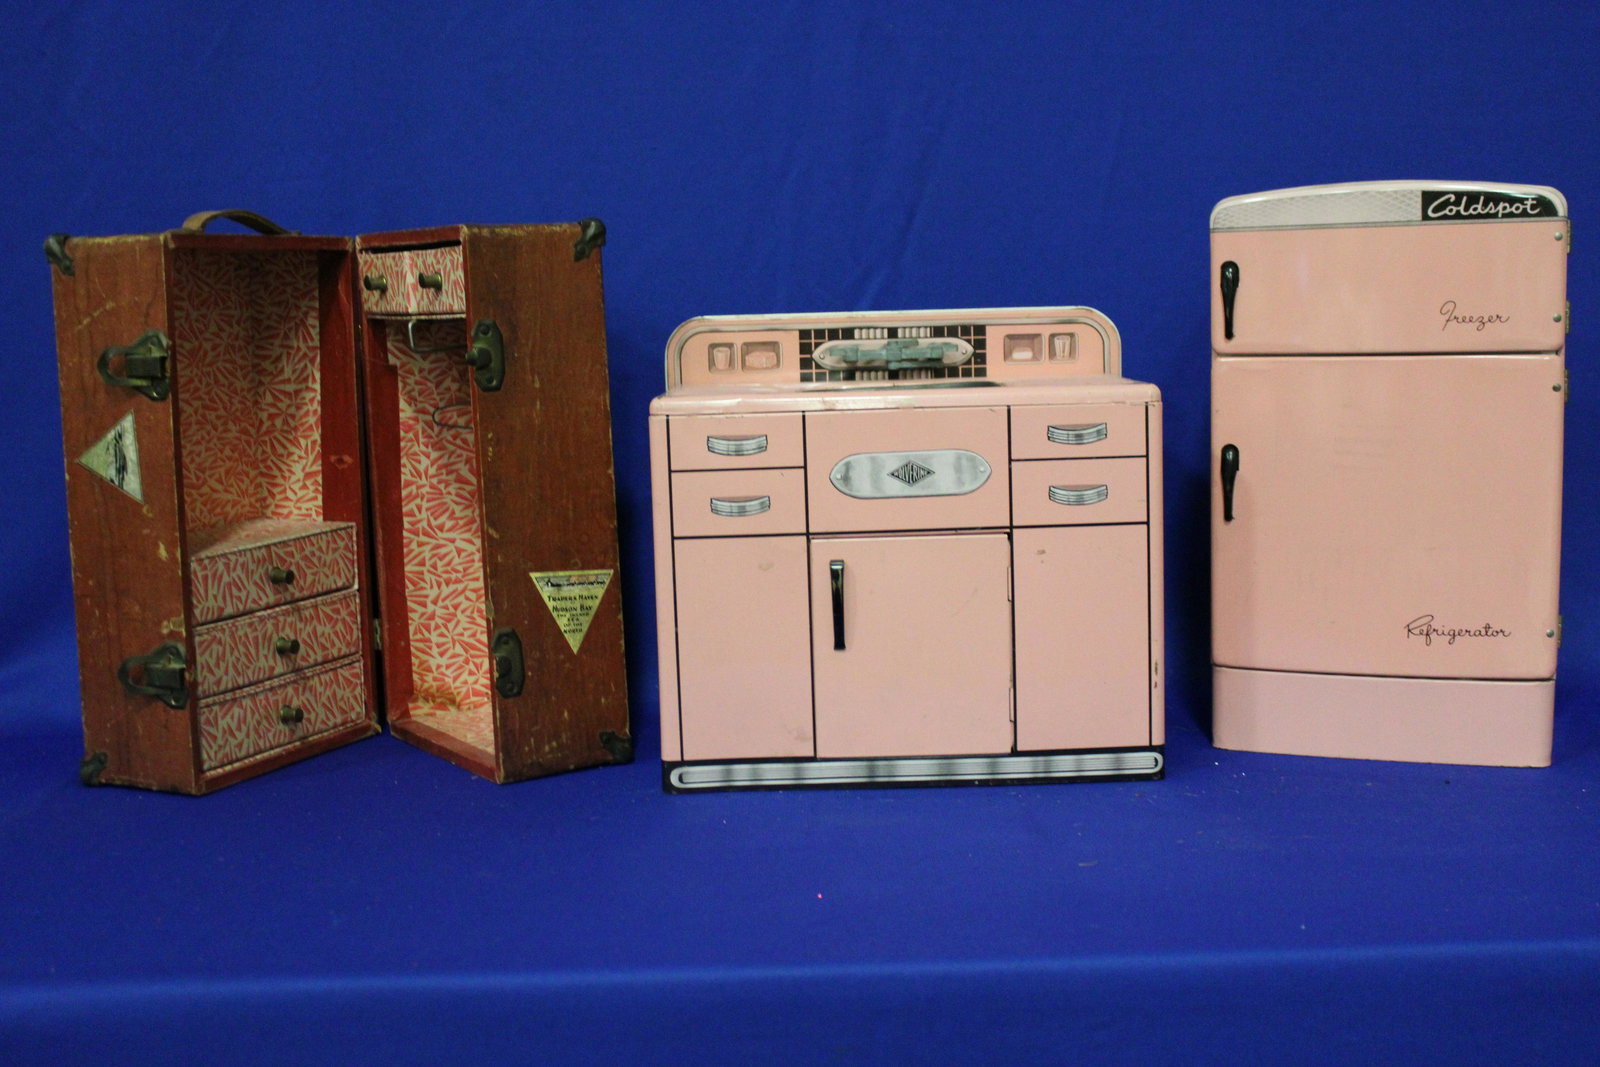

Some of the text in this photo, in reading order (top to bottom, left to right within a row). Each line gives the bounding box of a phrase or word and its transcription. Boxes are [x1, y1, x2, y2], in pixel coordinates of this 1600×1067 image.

[1427, 193, 1541, 218] Coldspot
[1439, 300, 1510, 332] Freezer
[893, 463, 927, 484] WOLVERINE
[552, 604, 593, 613] HUDSON BAY
[1404, 614, 1512, 646] Refrigerator
